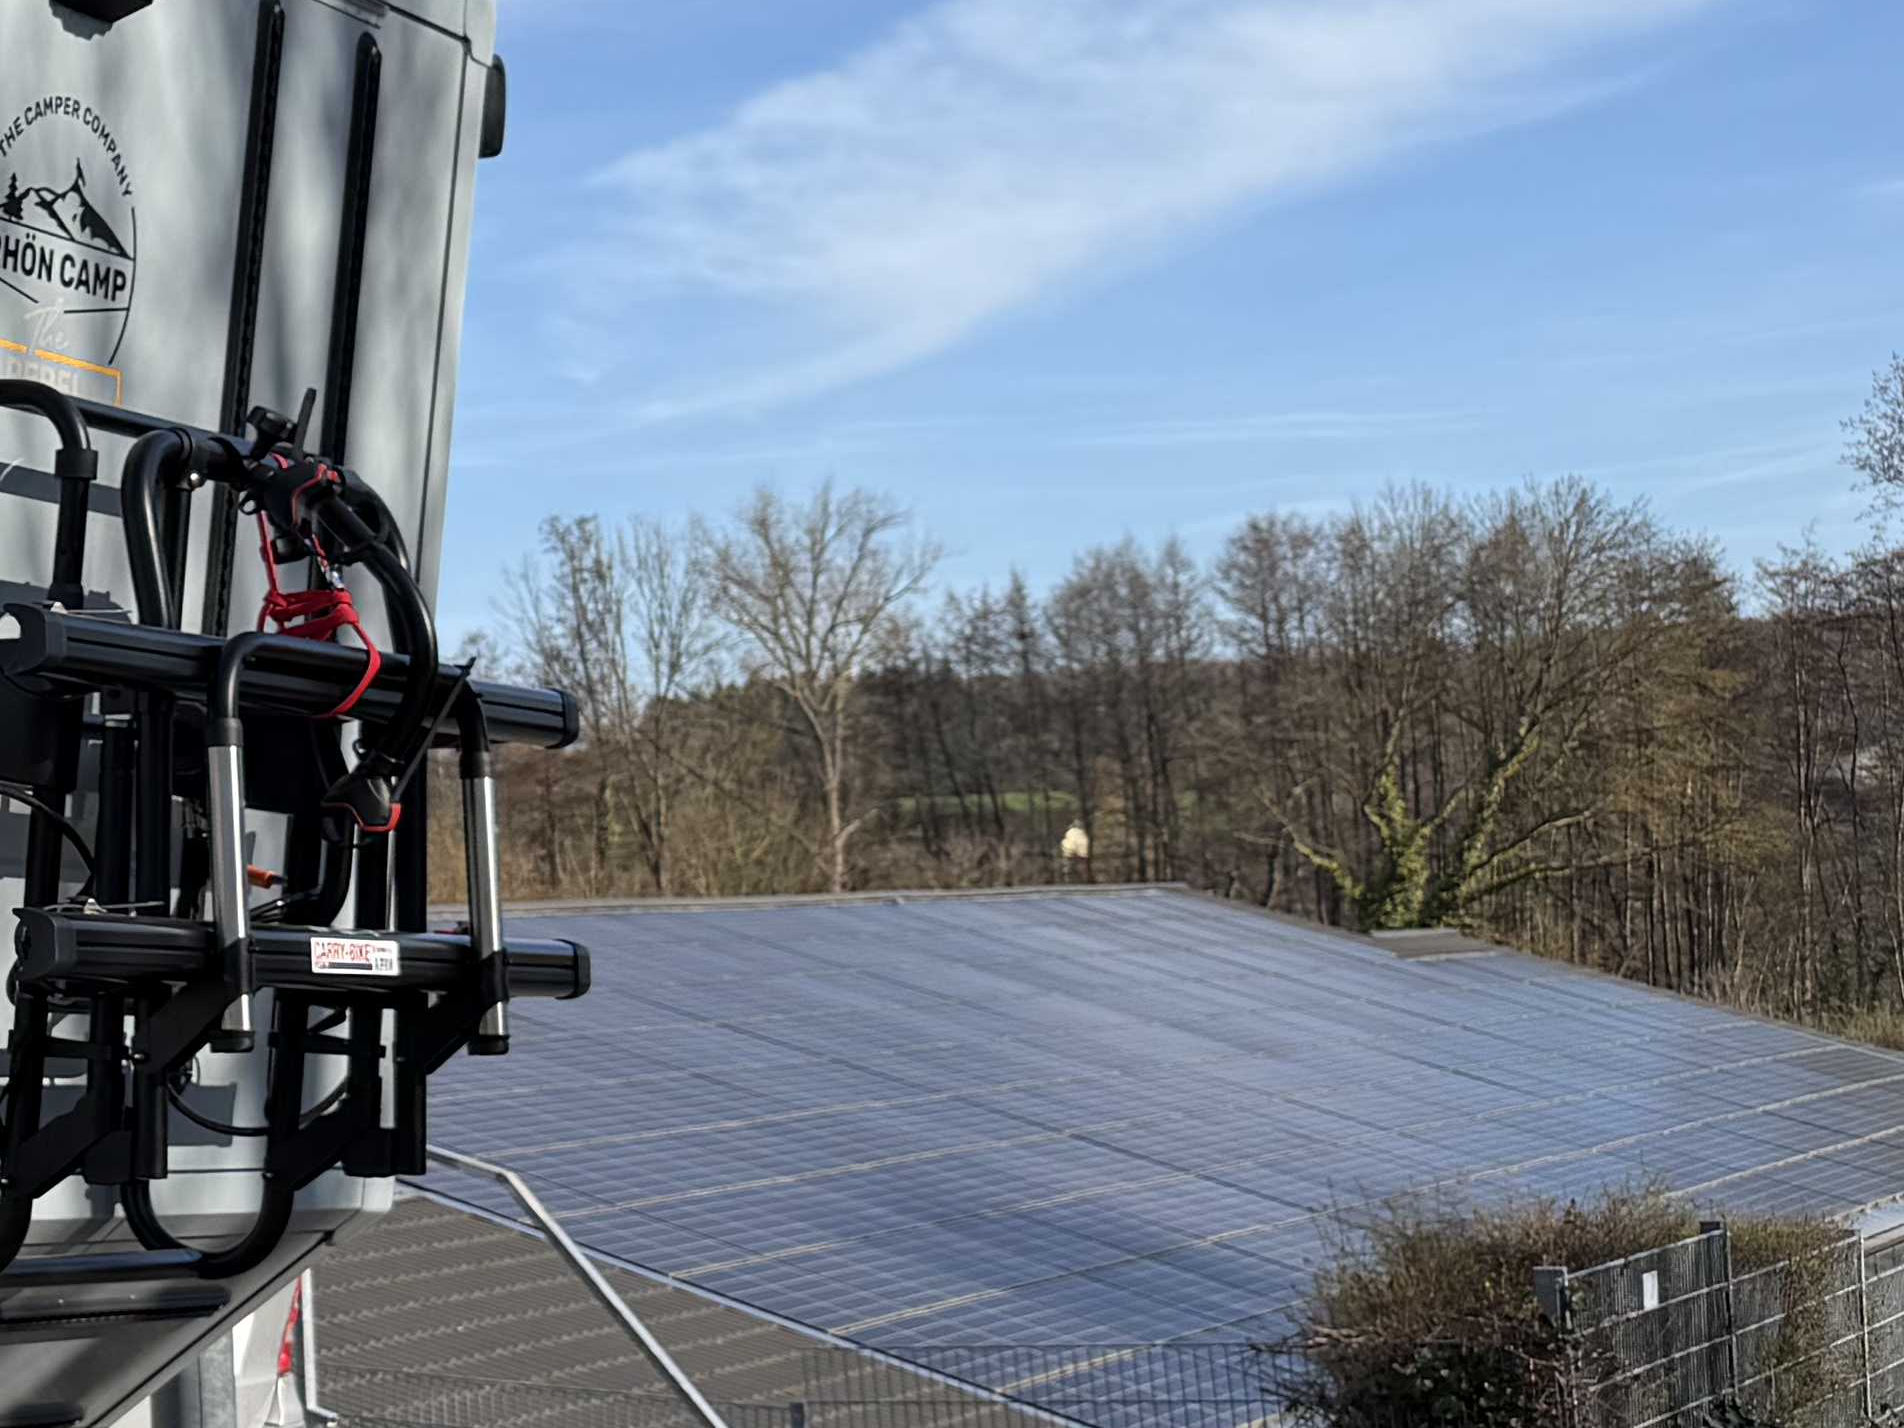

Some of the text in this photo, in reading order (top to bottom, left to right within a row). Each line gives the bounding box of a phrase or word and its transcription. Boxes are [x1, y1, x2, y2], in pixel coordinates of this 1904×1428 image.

[24, 96, 81, 125] CAMPER
[83, 107, 132, 196] COMPANY
[60, 254, 127, 302] CAMP
